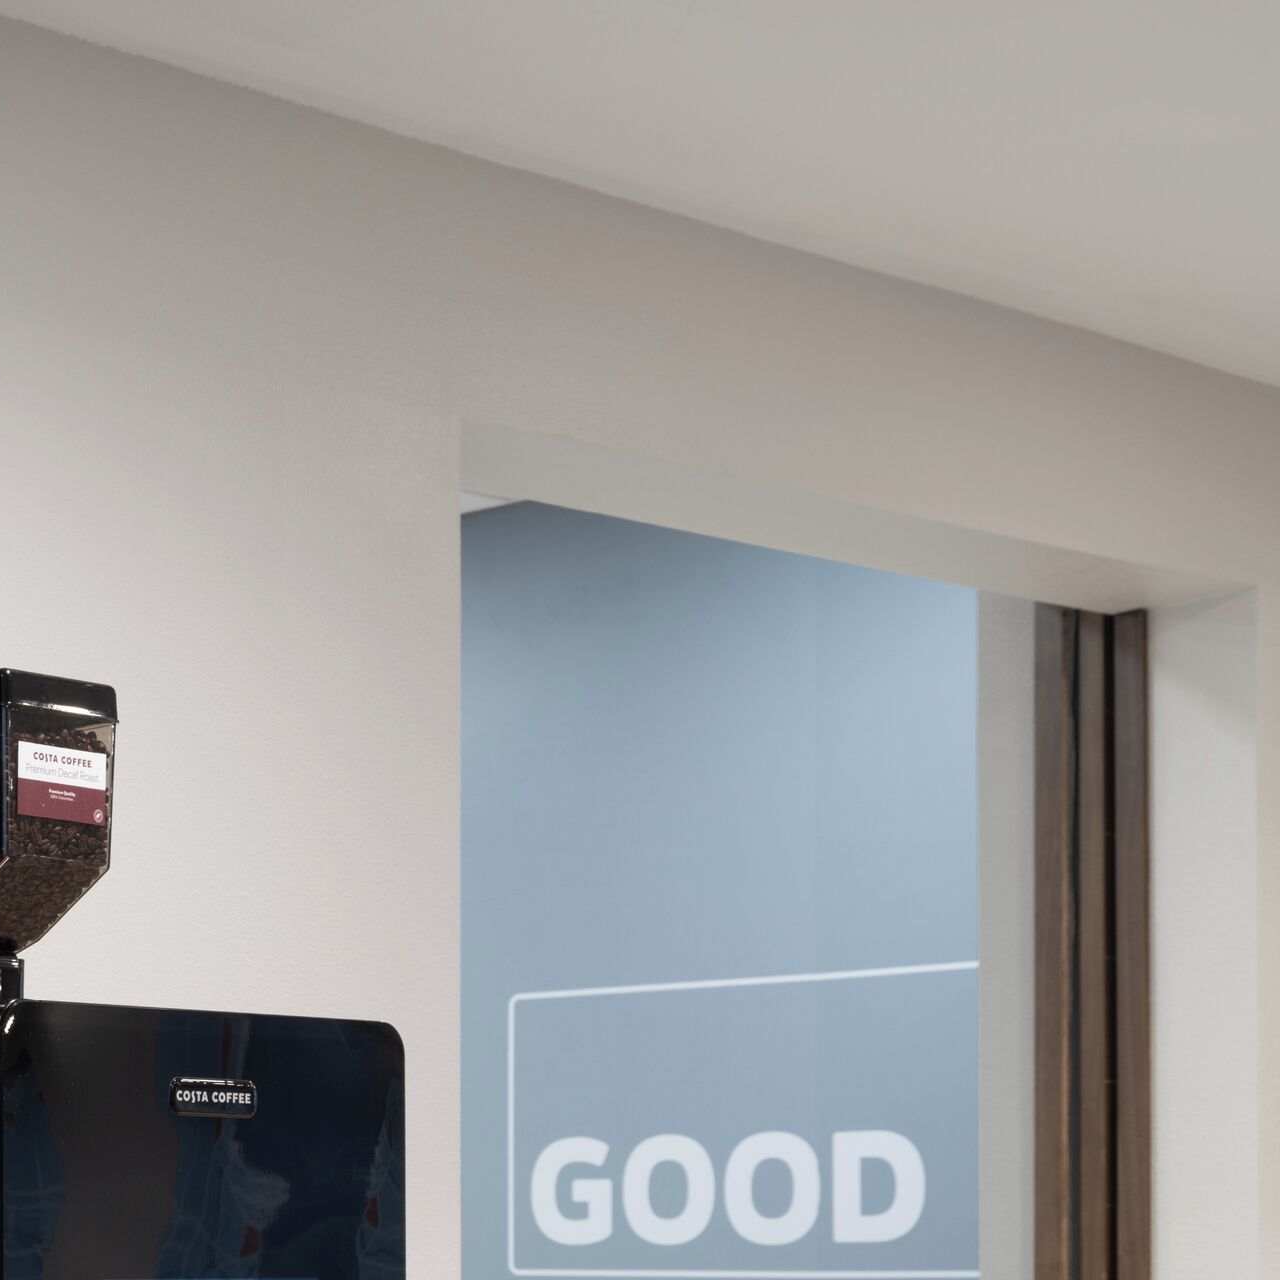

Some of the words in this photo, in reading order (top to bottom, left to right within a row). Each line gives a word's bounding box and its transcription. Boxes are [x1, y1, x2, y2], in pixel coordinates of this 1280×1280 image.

[33, 752, 58, 763] COSTA
[61, 756, 92, 768] COFFEE
[176, 1089, 209, 1103] COSTA
[211, 1091, 251, 1104] COFFEE
[530, 1129, 926, 1246] GOOD
